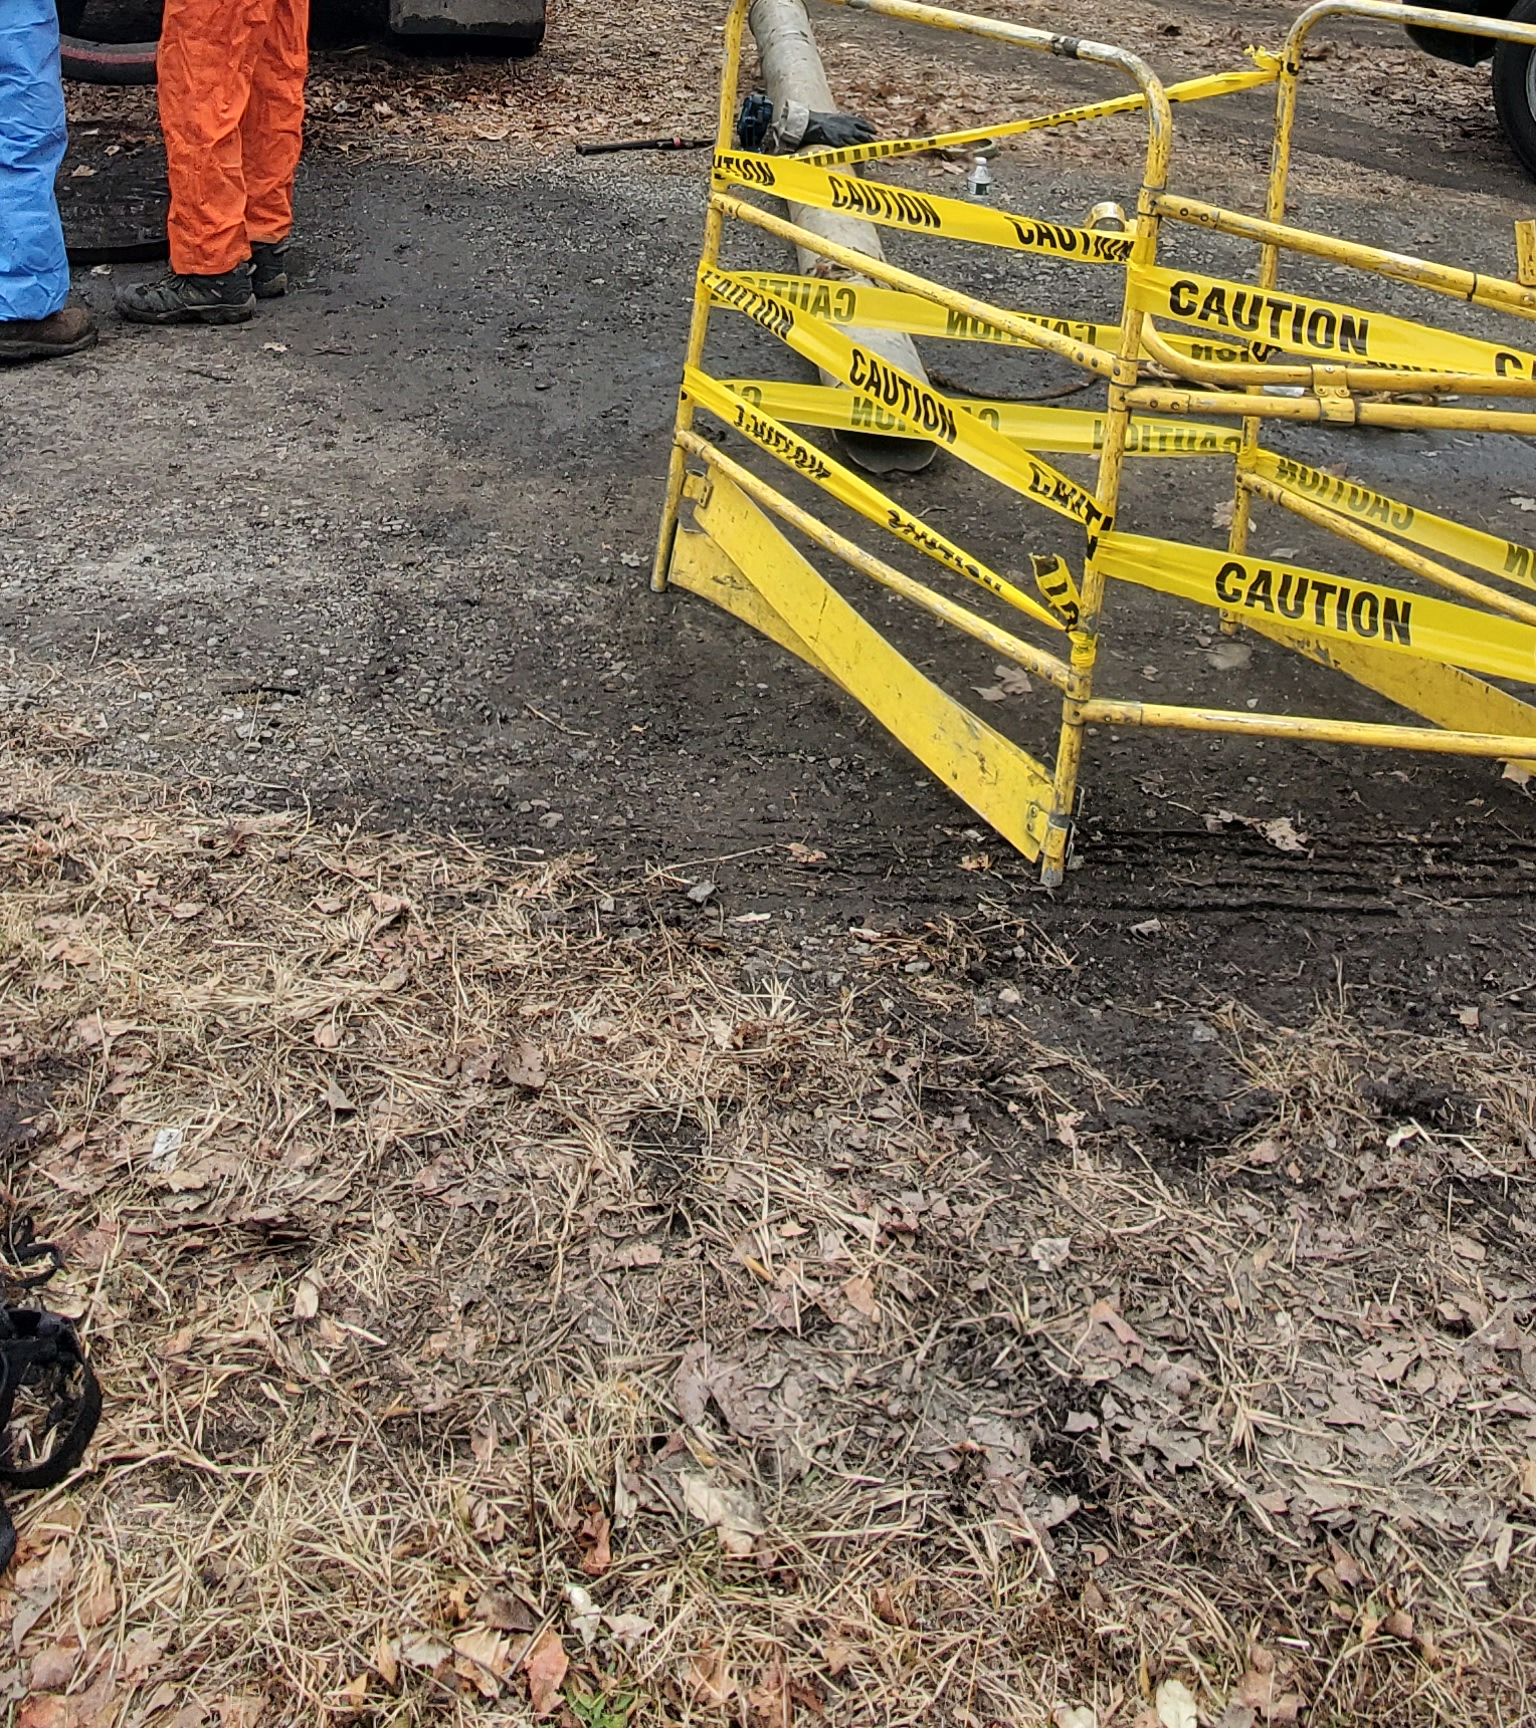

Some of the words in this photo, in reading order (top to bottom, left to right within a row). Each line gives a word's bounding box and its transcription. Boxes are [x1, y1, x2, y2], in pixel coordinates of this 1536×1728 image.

[828, 176, 941, 228] CAUTION
[1170, 279, 1368, 356] CAUTION
[850, 348, 958, 444] CAUTION
[1215, 562, 1412, 646] CAUTION
